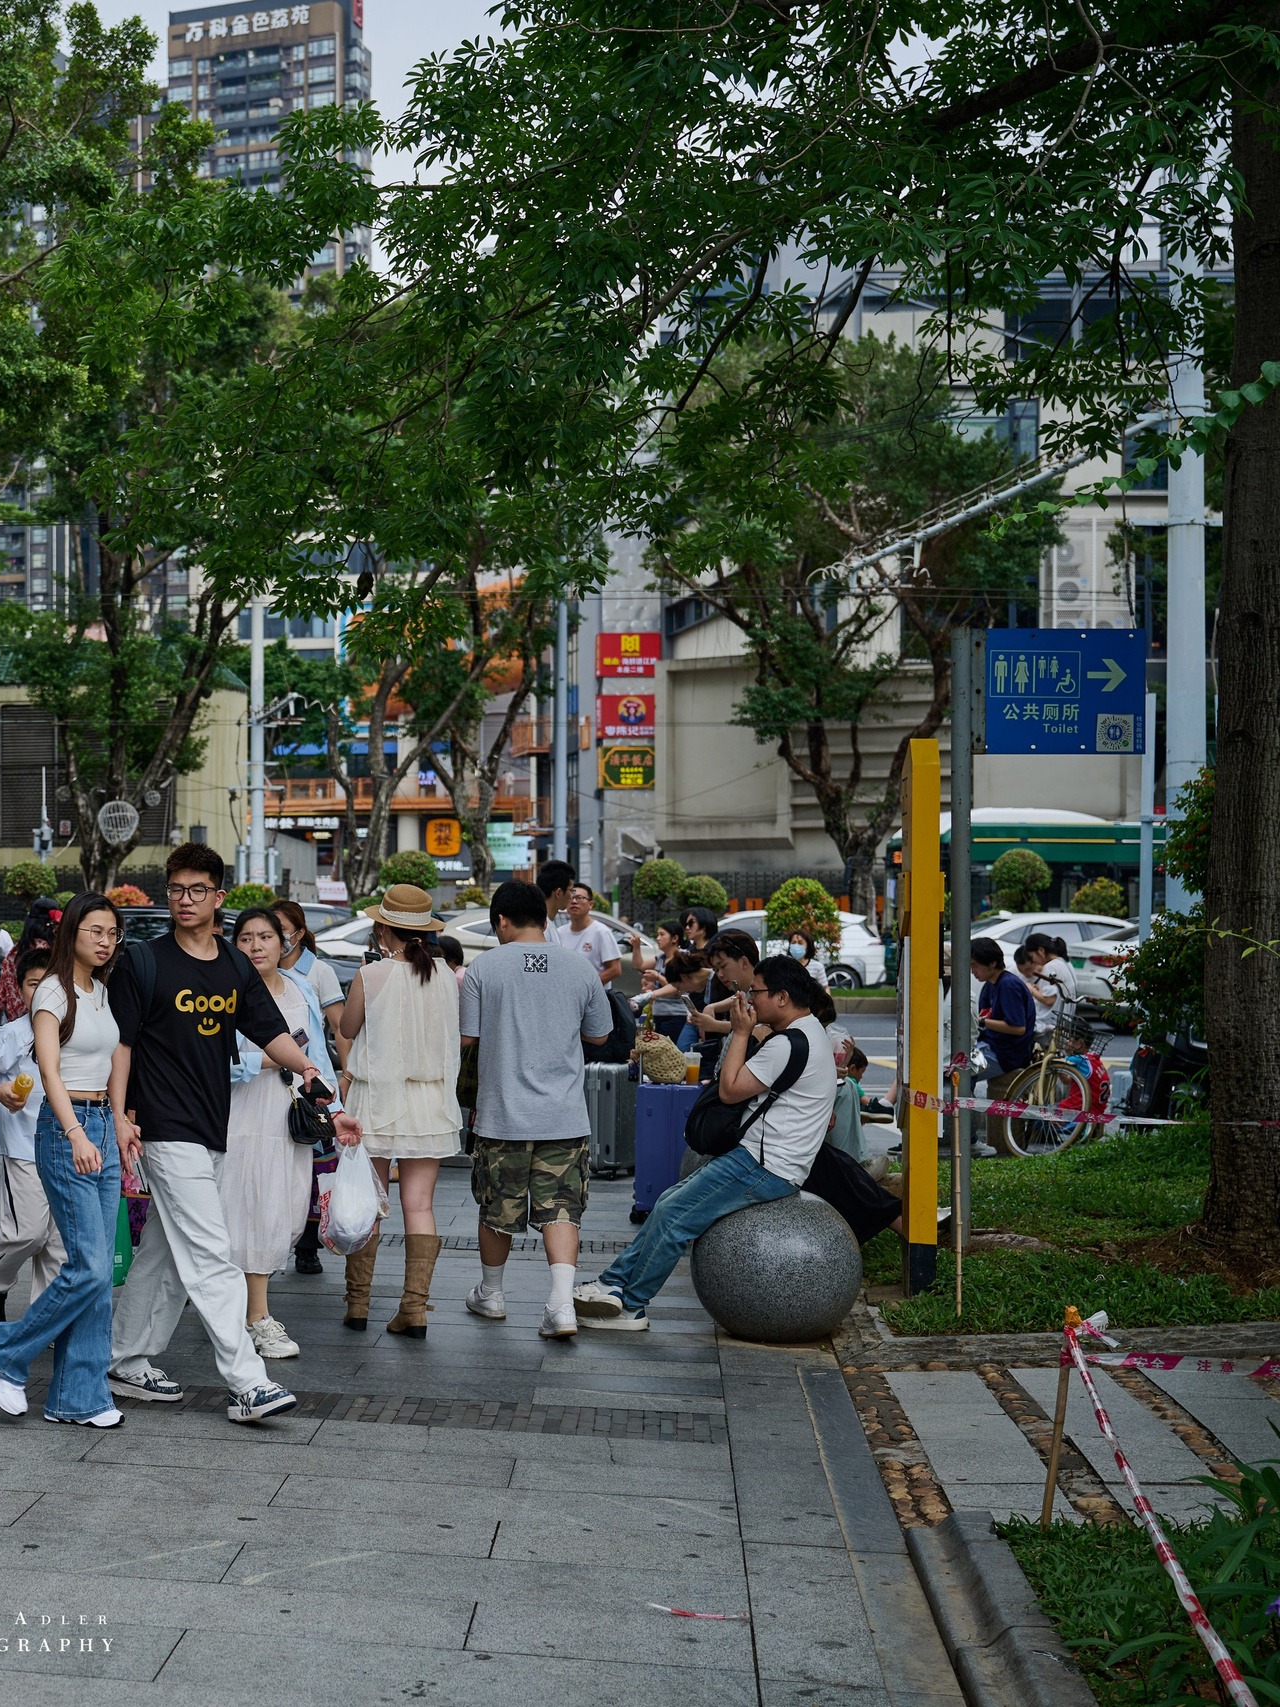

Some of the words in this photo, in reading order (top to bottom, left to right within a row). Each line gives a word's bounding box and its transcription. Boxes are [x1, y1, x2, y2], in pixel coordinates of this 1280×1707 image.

[185, 4, 310, 43] 万科金色荔苑
[1002, 703, 1080, 721] 公共厕所
[1043, 723, 1079, 734] Toilet
[175, 988, 237, 1014] Good
[997, 1102, 1018, 1111] 安全
[1134, 1357, 1165, 1369] 安全
[1197, 1360, 1235, 1373] 注意
